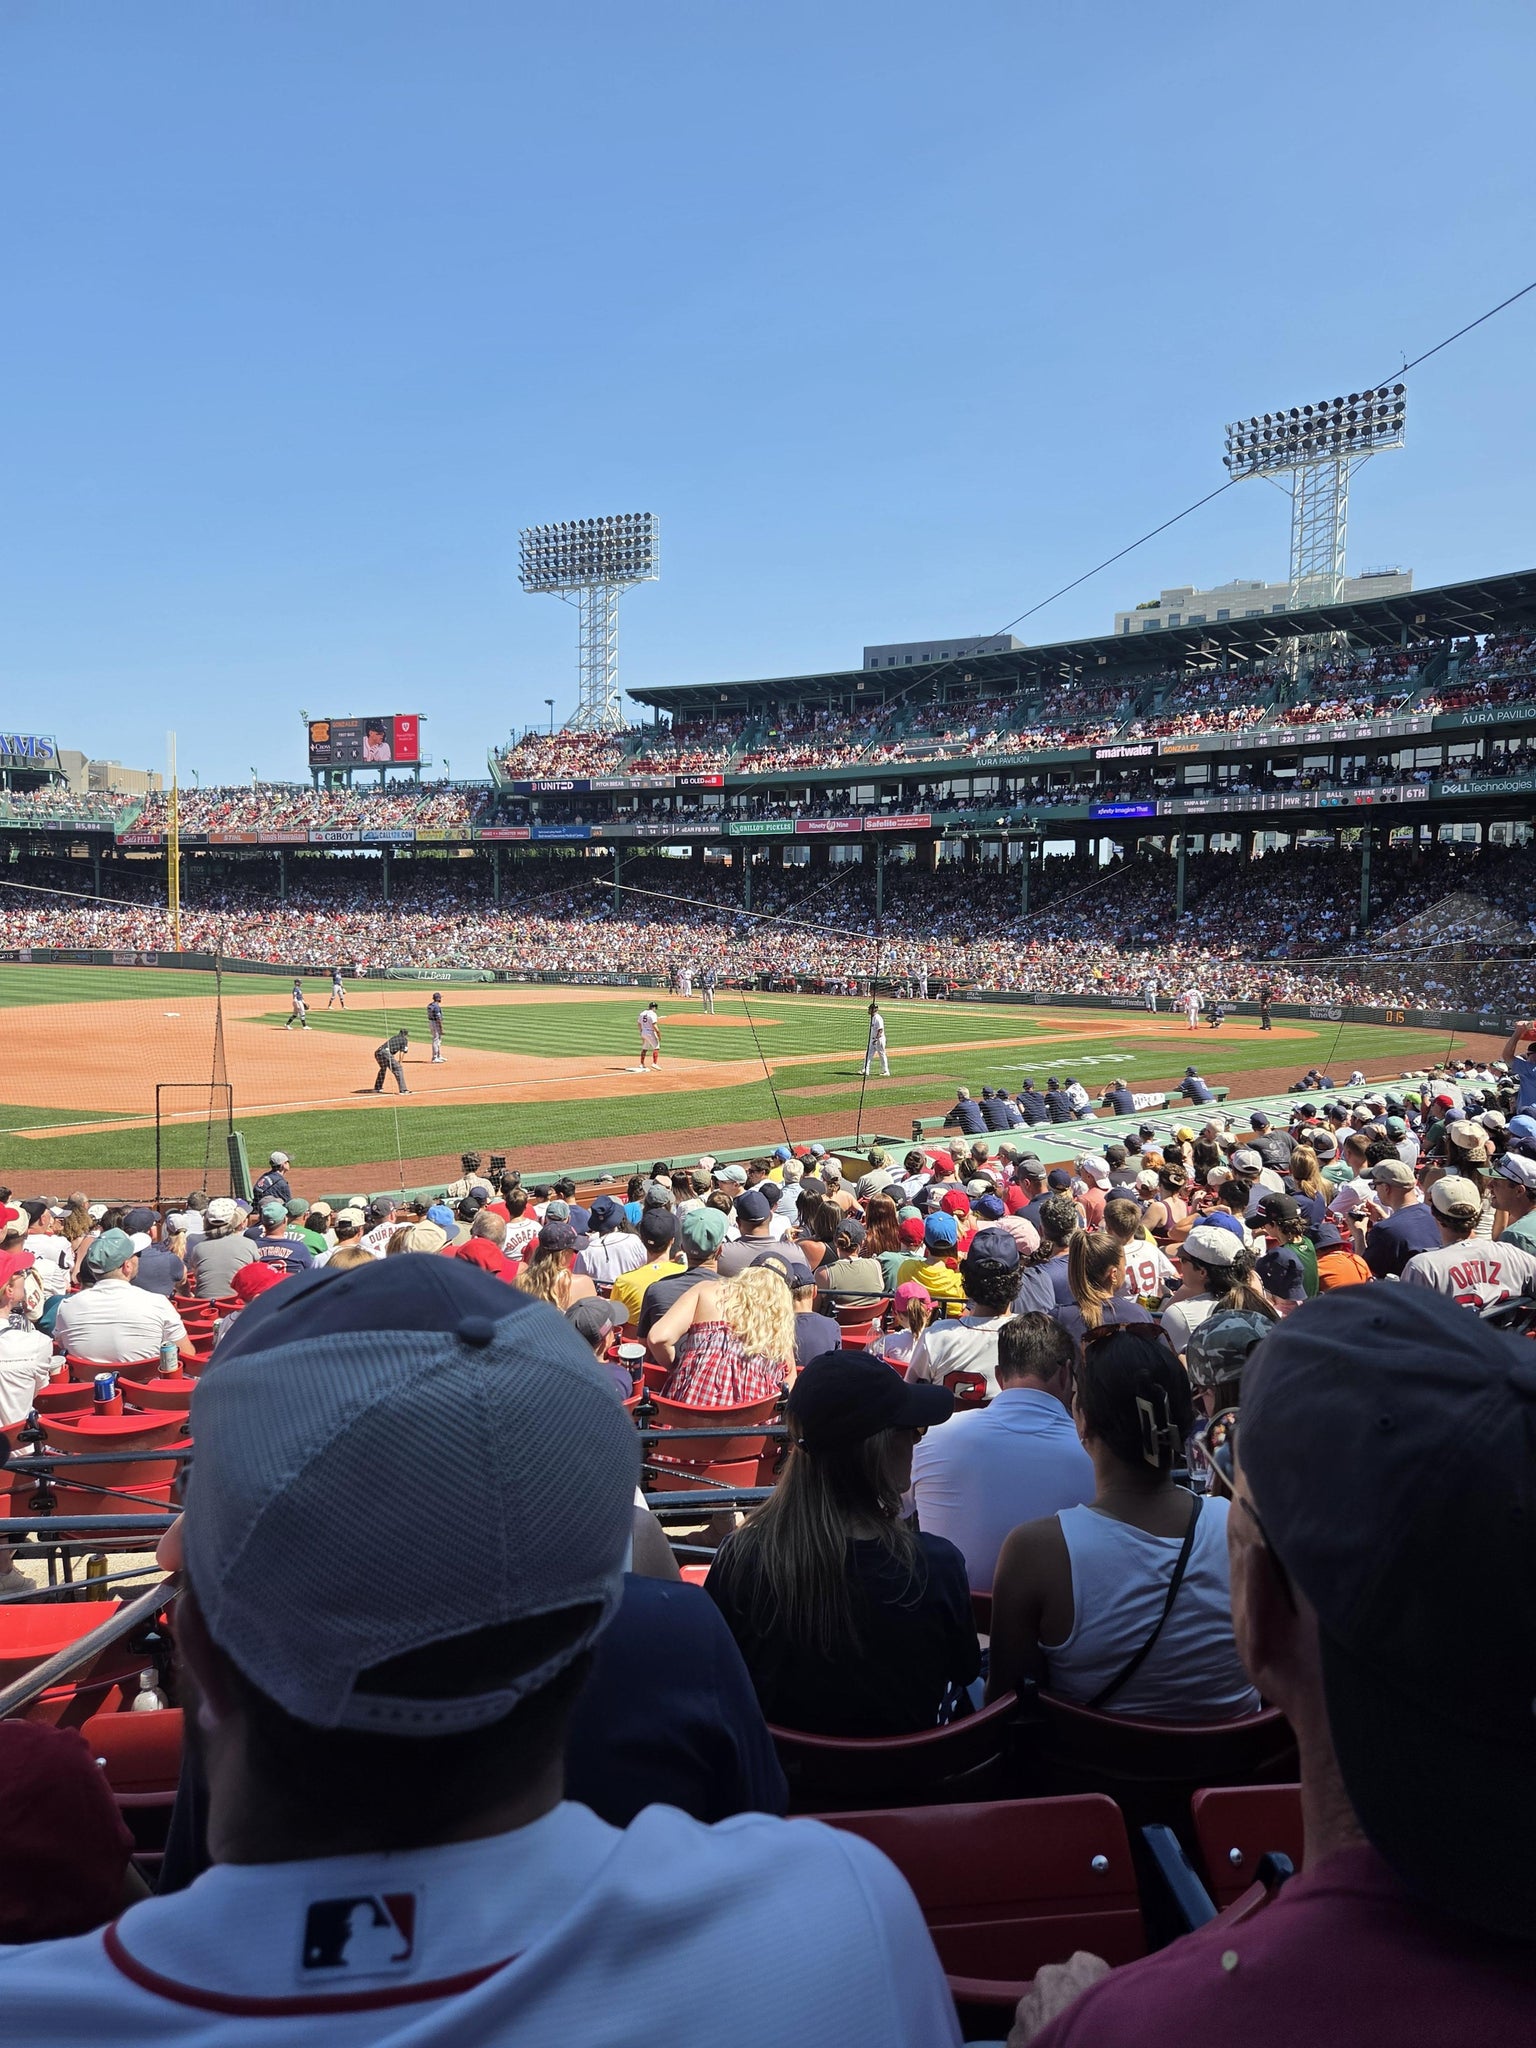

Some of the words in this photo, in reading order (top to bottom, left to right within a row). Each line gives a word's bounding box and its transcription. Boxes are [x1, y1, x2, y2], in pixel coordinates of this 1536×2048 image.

[1163, 744, 1200, 753] GONZALEZ
[1258, 738, 1268, 746] 45
[1095, 744, 1154, 760] smartwater
[999, 756, 1030, 764] PAVILION
[540, 782, 574, 790] UNITED
[1442, 784, 1470, 794] DELL
[1470, 780, 1532, 793] Technologies
[1406, 788, 1426, 798] 6TH
[1284, 797, 1300, 805] MVR
[1114, 807, 1136, 815] Imagine
[766, 823, 791, 831] PICKLES
[866, 819, 897, 828] Safelite
[418, 970, 451, 980] L.L.Bean
[642, 1014, 648, 1023] 5
[283, 1232, 306, 1241] RTIZ
[258, 1245, 294, 1258] NTHONY
[1126, 1260, 1156, 1294] 19
[1449, 1260, 1502, 1290] ORTIZ
